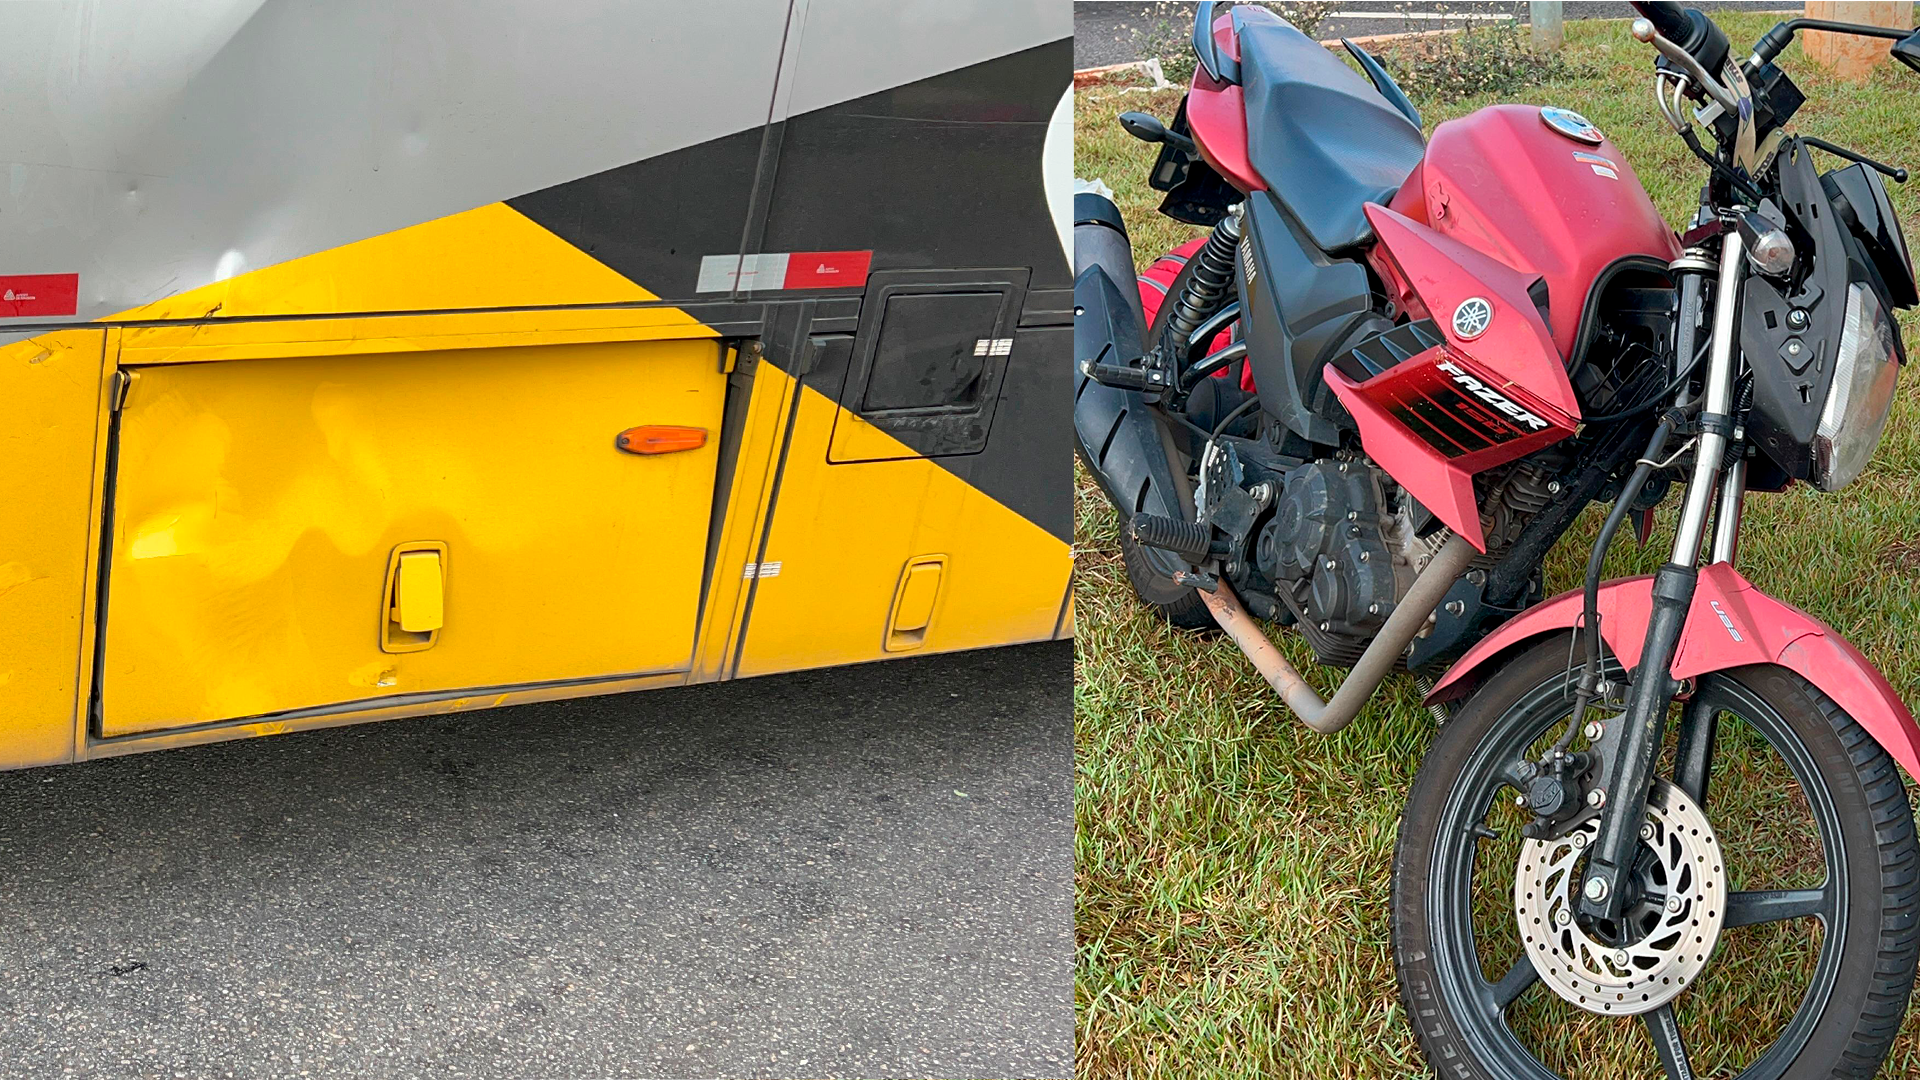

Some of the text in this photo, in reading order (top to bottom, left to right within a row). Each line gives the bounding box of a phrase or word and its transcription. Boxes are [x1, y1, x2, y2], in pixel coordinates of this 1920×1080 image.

[1240, 235, 1257, 285] YAMAHA
[1436, 359, 1548, 431] FAZER
[1455, 402, 1508, 434] 150
[1709, 600, 1745, 642] UBS
